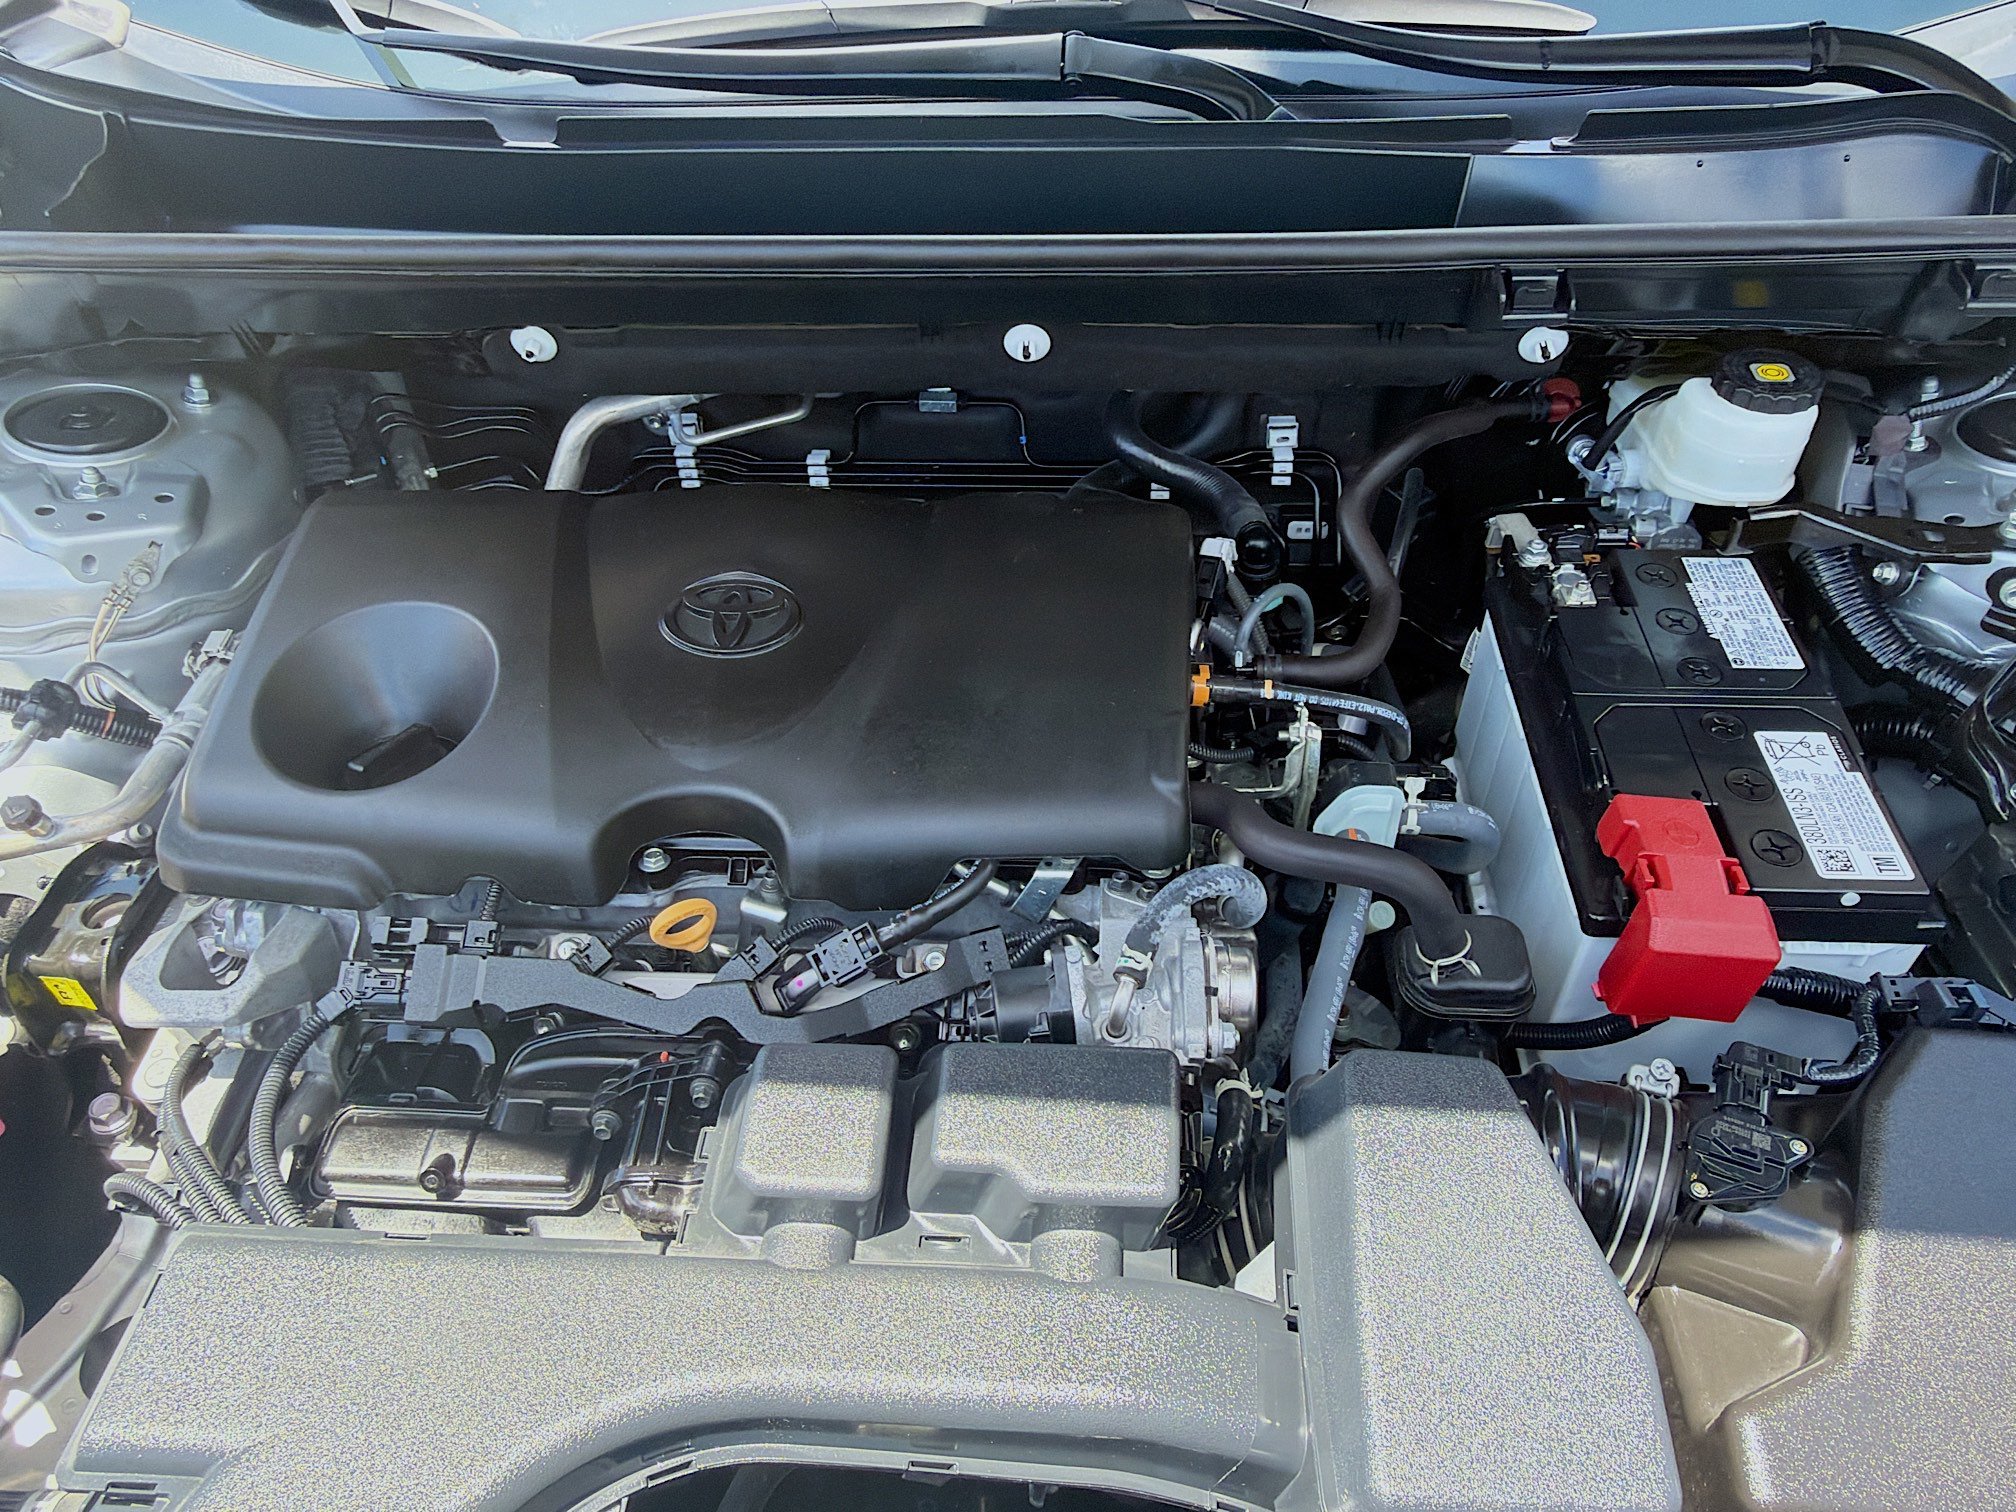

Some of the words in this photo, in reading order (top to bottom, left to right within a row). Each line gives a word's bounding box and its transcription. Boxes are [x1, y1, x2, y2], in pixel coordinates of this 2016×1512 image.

[1684, 582, 1704, 606] POISON
[1696, 606, 1717, 633] DANGER
[1815, 744, 1829, 756] Pb
[1829, 735, 1848, 760] CLARIOS
[1873, 857, 1900, 873] TM
